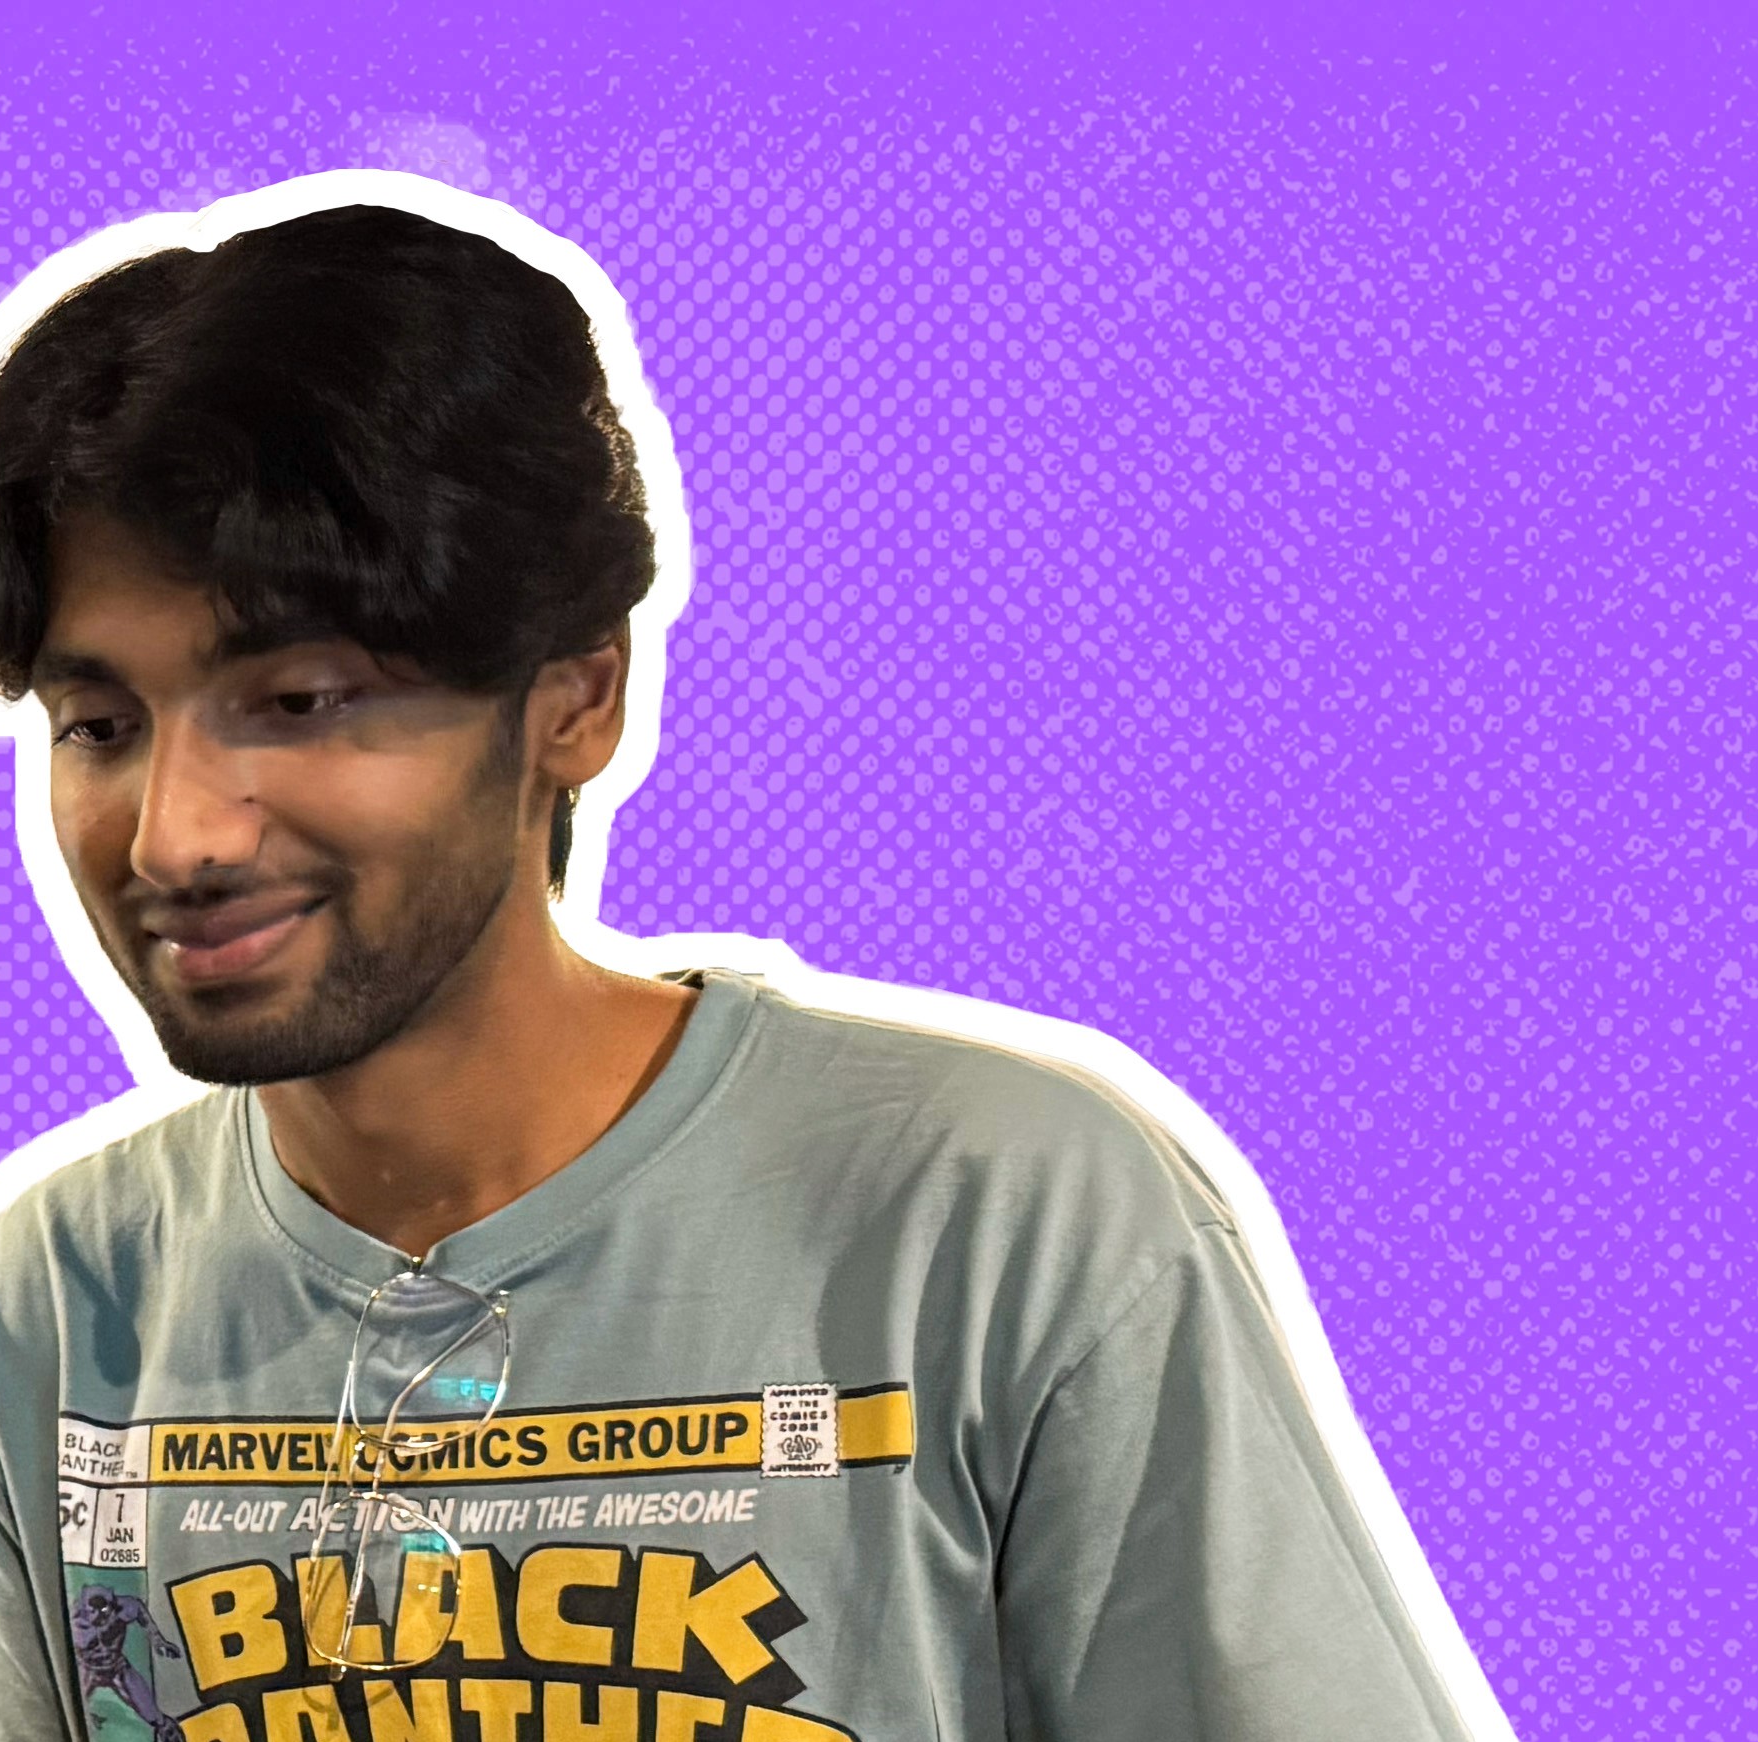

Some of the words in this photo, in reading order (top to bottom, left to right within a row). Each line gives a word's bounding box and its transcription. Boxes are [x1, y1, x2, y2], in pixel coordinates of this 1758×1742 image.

[769, 1388, 829, 1397] APPROVED
[778, 1400, 791, 1409] BY
[799, 1400, 819, 1408] THE
[769, 1411, 828, 1421] COMICS
[779, 1423, 819, 1432] CODE
[64, 1432, 123, 1457] BLACK
[162, 1432, 340, 1473] MARVEL
[354, 1424, 548, 1472] COMICS
[569, 1412, 748, 1463] GROUP
[61, 1454, 124, 1477] ANTHE
[768, 1463, 831, 1472] AUTHORITY
[180, 1499, 288, 1533] ALL-OUT
[289, 1497, 456, 1532] ACTION
[459, 1499, 533, 1533] WITH
[536, 1495, 588, 1530] THE
[592, 1487, 758, 1528] AWESOME
[105, 1527, 134, 1543] JAN
[169, 1544, 791, 1692] BLACK
